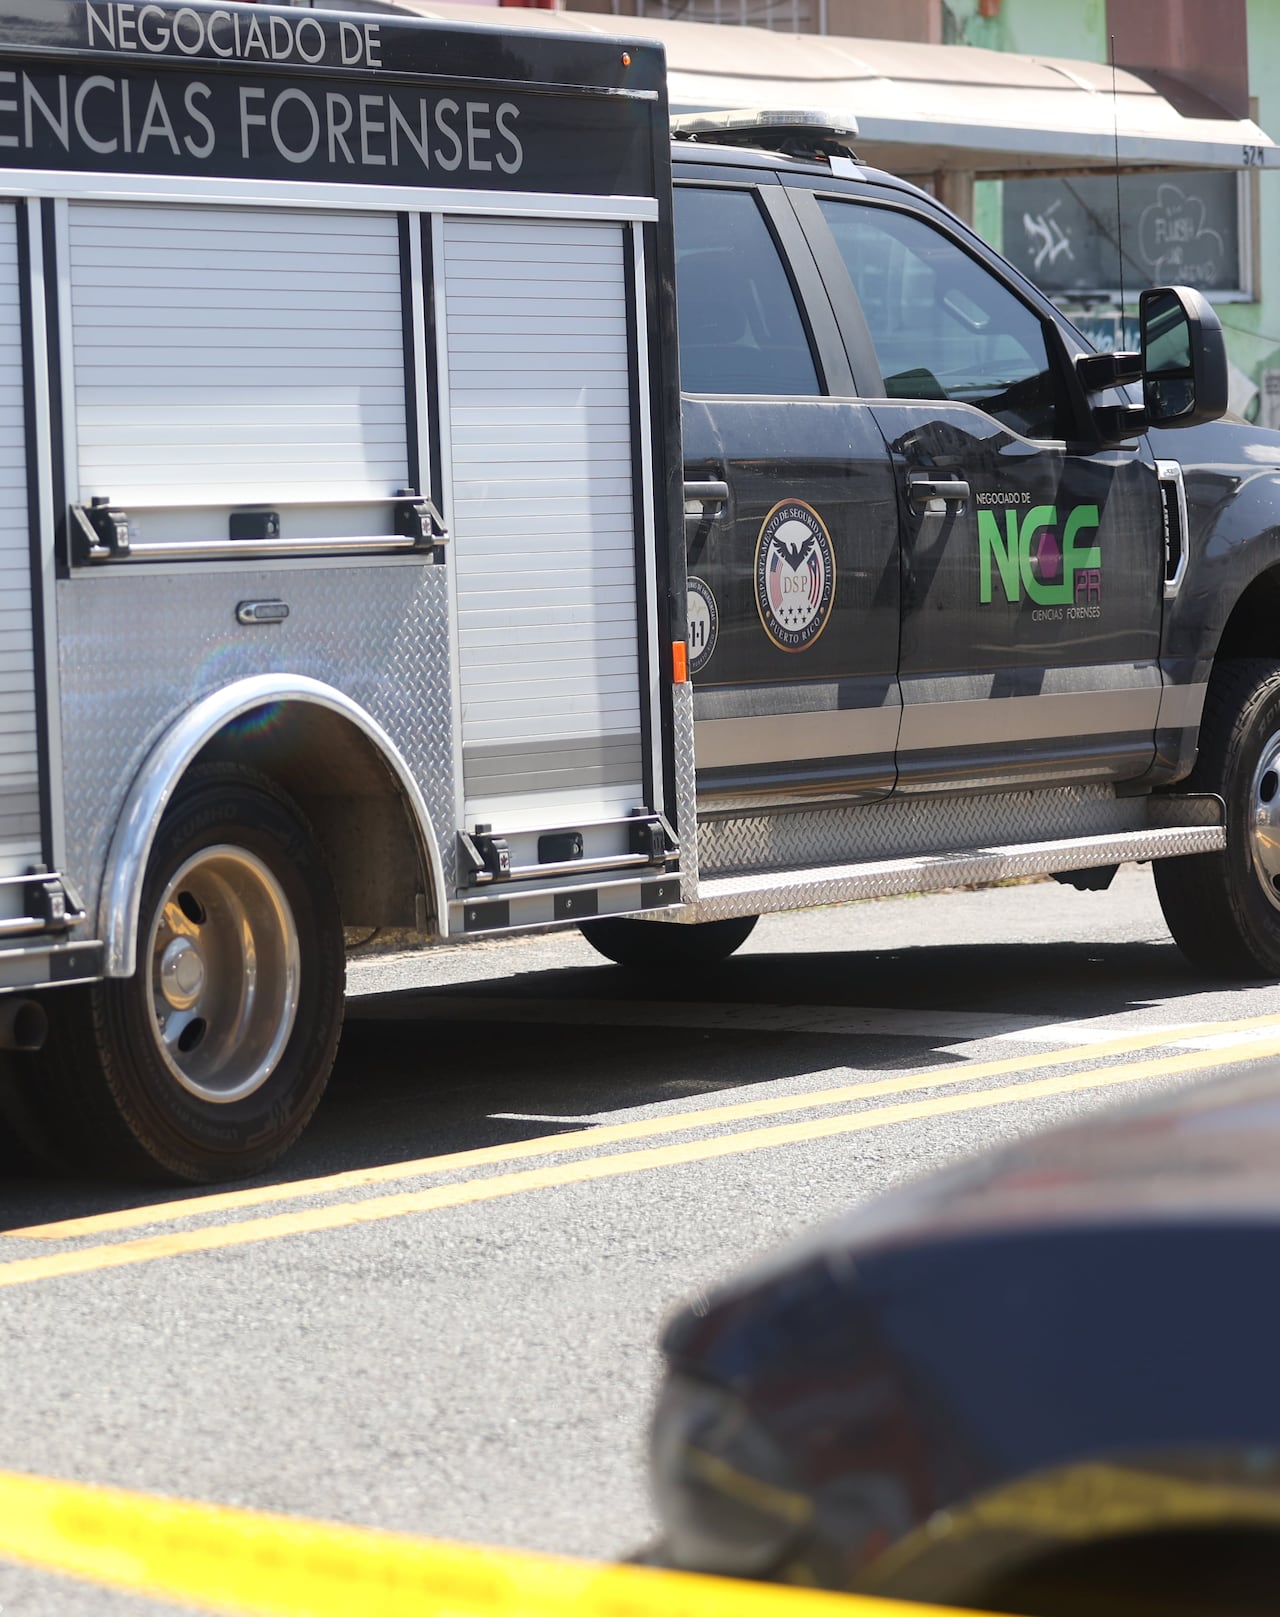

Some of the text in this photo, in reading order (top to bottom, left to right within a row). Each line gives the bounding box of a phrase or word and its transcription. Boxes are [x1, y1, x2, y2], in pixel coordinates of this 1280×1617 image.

[86, 1, 382, 67] NEGOCIADO DE
[238, 86, 523, 174] FORENSES
[976, 492, 1031, 504] NEGOCIADO DE
[759, 517, 780, 607] DEPARTAMENTO
[779, 510, 790, 521] DE
[789, 508, 826, 547] SEGURIDAD
[783, 575, 808, 594] DSP
[1075, 569, 1102, 603] PR
[1031, 606, 1101, 621] CIENCIAS FORENSES
[770, 617, 821, 643] PUERTO RICO
